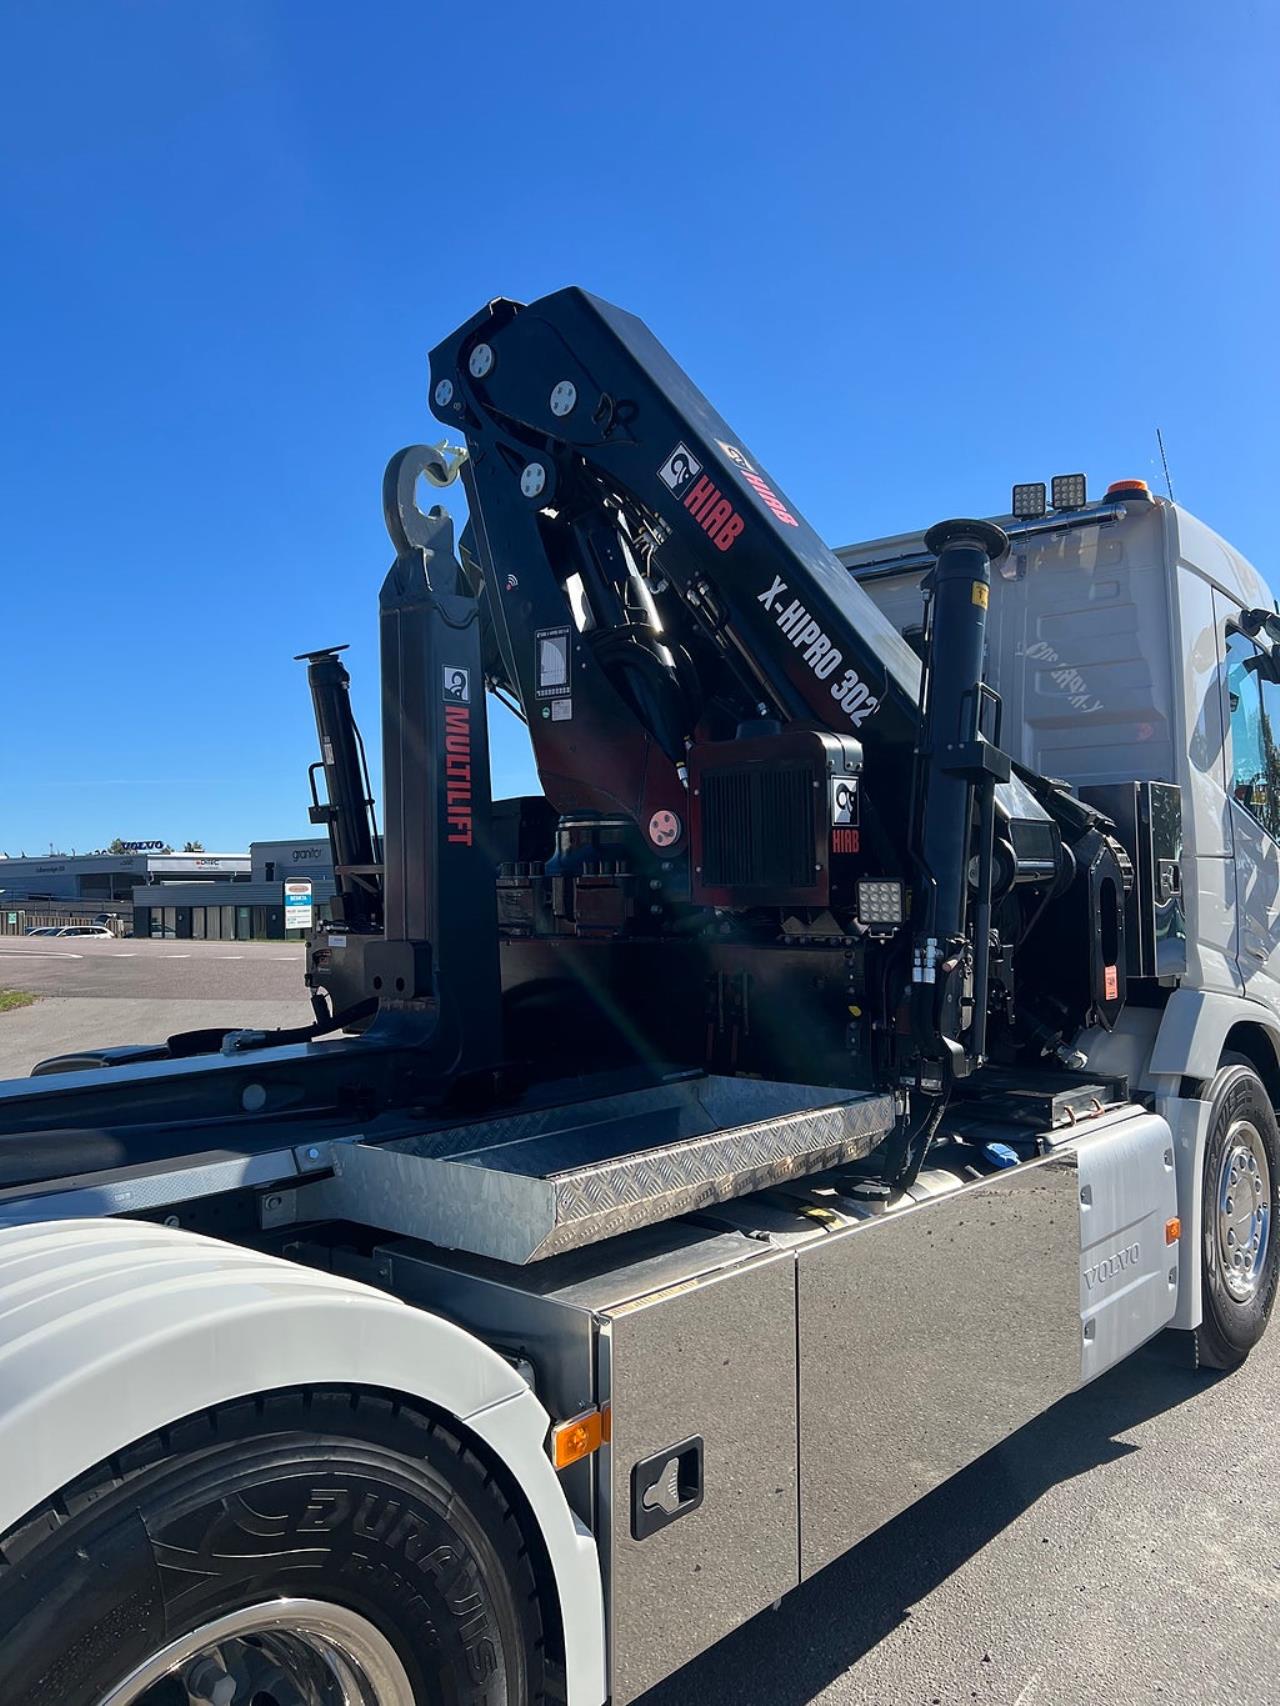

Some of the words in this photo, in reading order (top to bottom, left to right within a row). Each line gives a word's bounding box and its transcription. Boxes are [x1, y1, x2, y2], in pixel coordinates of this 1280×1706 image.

[683, 474, 745, 551] HIAB
[740, 469, 799, 527] HIAB
[757, 574, 843, 680] X-HIPRO
[830, 669, 878, 728] 302
[445, 705, 472, 846] MULTILIFT
[120, 840, 164, 851] VOLVO
[832, 829, 860, 853] HIAB
[1083, 1242, 1139, 1290] VOLVO
